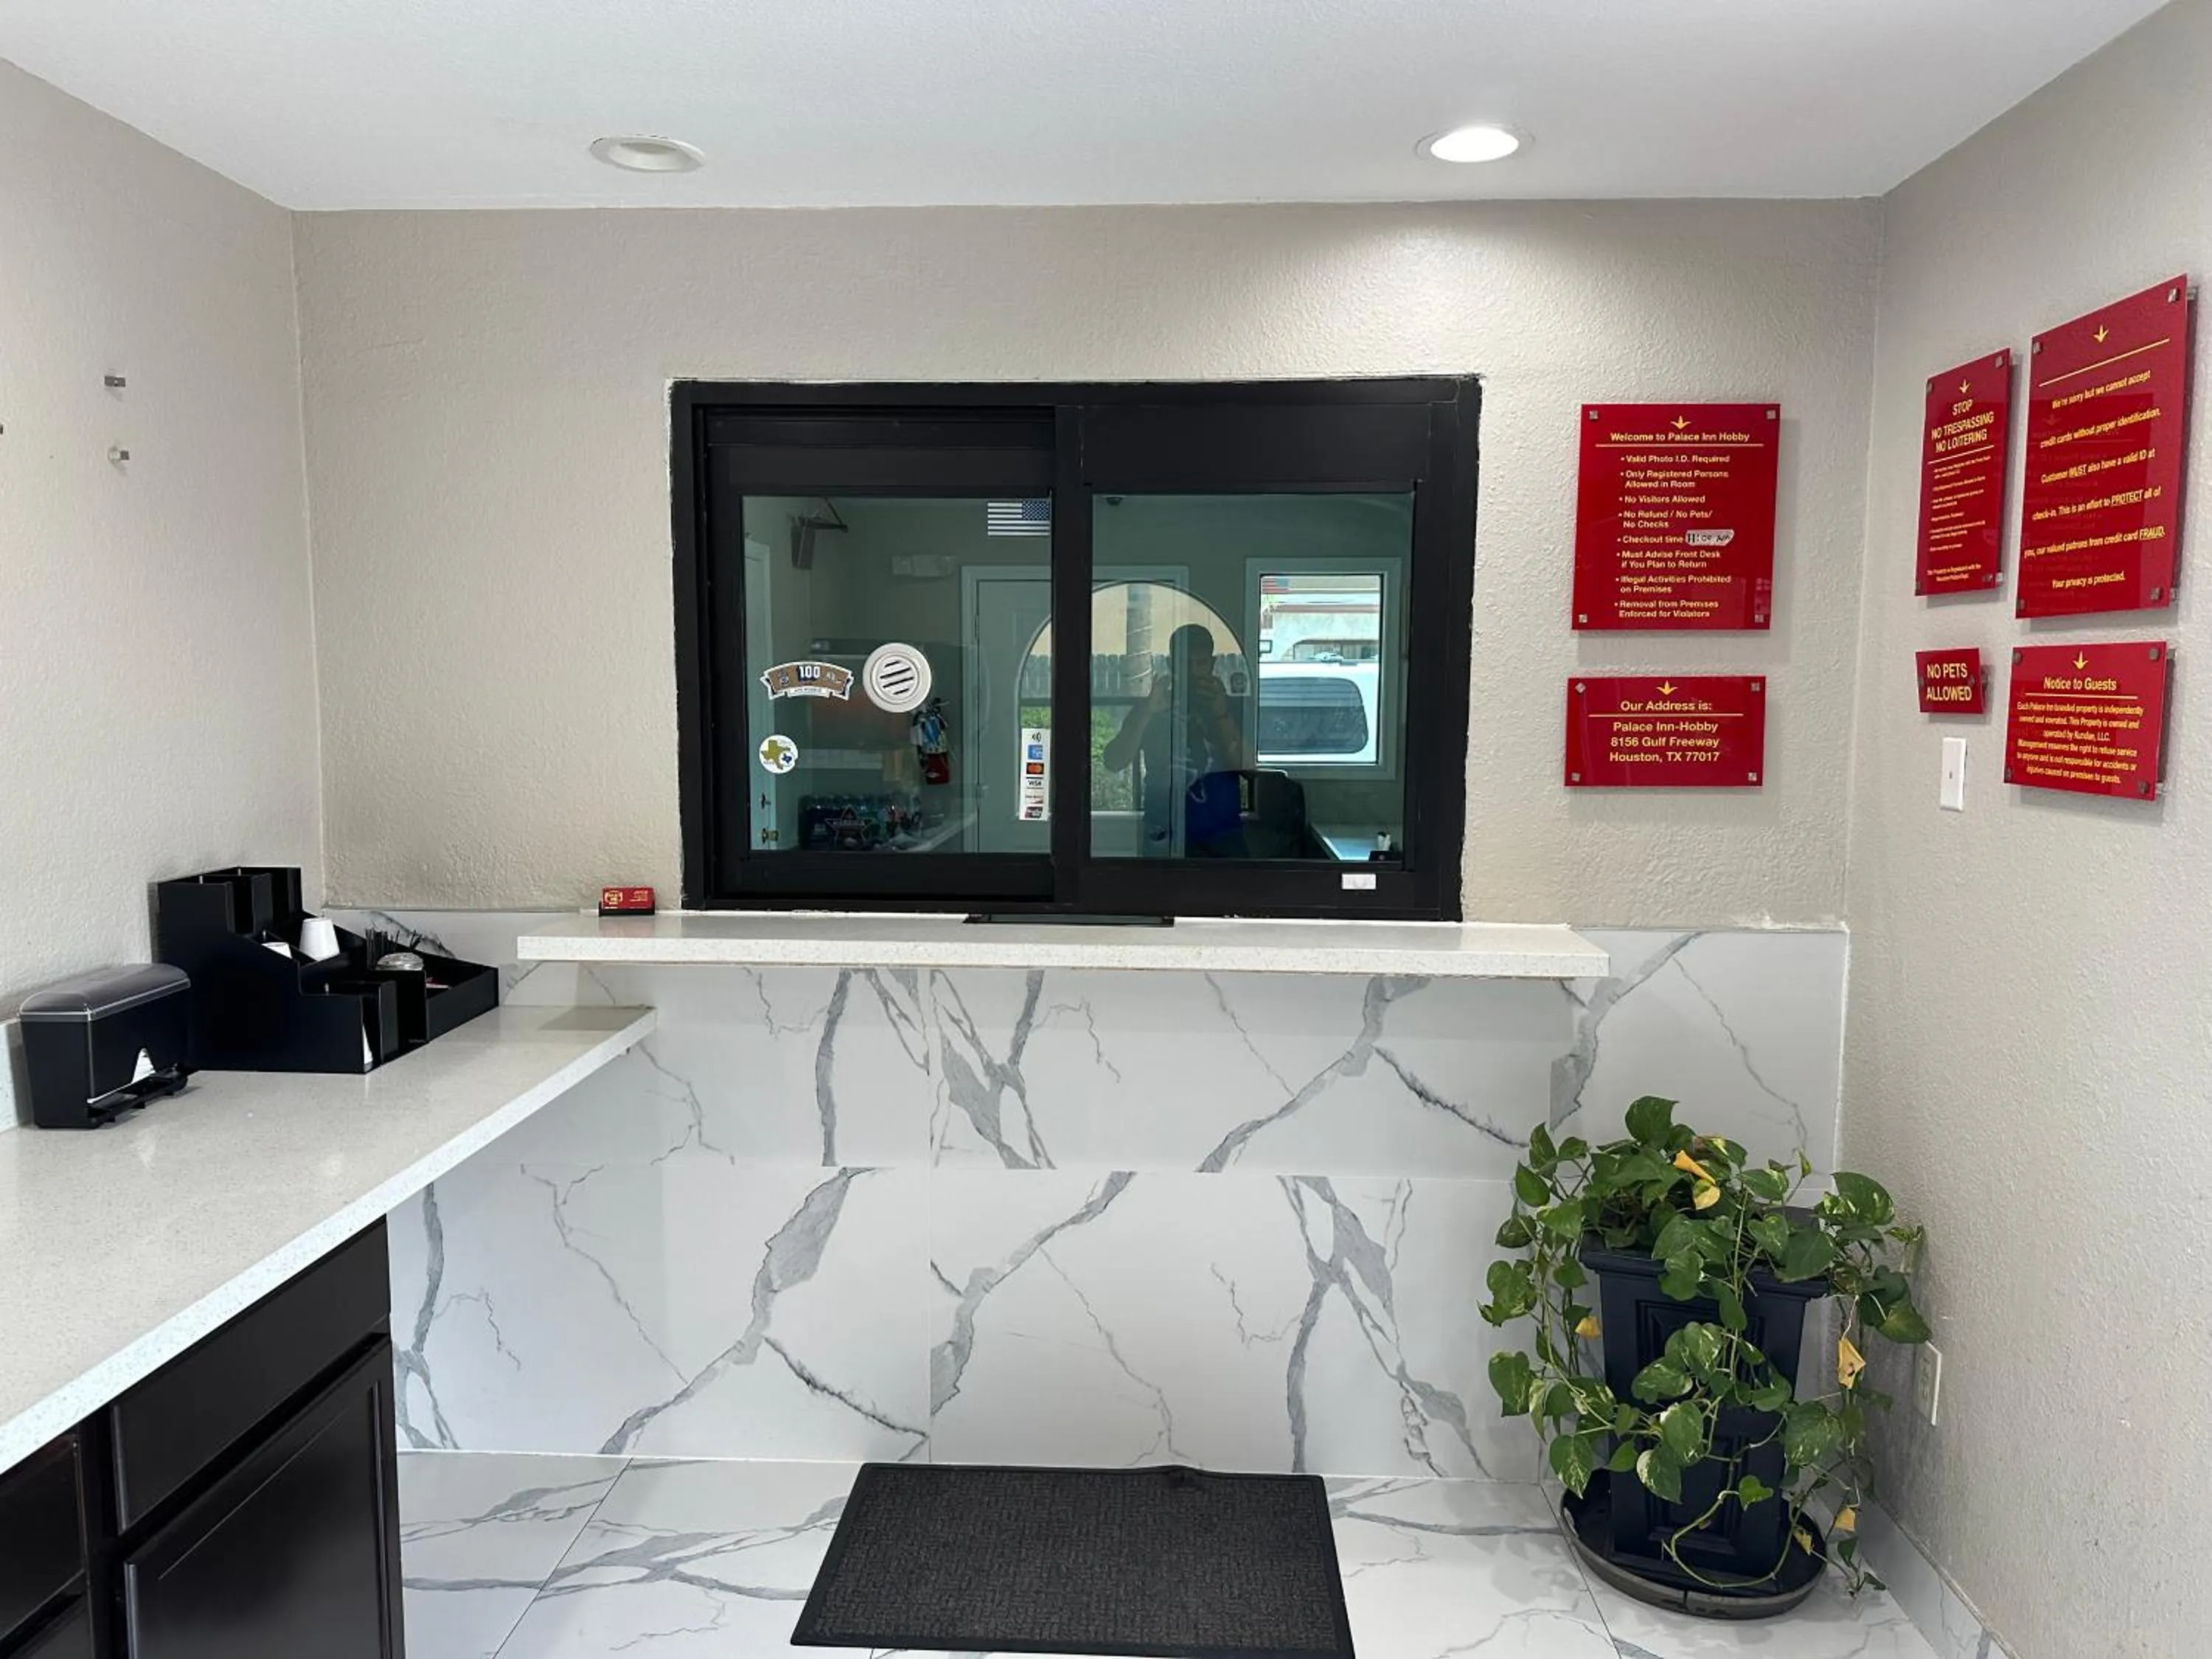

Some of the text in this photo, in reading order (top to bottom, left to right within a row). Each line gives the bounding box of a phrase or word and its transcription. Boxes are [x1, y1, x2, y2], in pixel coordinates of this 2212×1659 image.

[2053, 370, 2150, 409] We're sorry but we cannot accept
[1952, 399, 1972, 416] STOP
[1932, 411, 1994, 440] NO TRESPASSING
[2040, 408, 2160, 448] credit cards without proper identification.
[1610, 433, 1653, 441] Welcome
[1668, 433, 1700, 441] Palace
[1703, 433, 1717, 441] Inn
[1719, 433, 1750, 442] Hobby
[1935, 429, 1987, 453] NO LOITERING
[1692, 455, 1730, 463] Required
[2041, 470, 2067, 484] Customer
[2069, 465, 2087, 478] MUST
[2088, 462, 2100, 473] also
[2101, 459, 2116, 469] have
[2124, 452, 2138, 464] valid
[2140, 450, 2146, 460] ID
[2149, 448, 2155, 459] at
[1626, 470, 1644, 479] Only
[1647, 470, 1691, 479] Registered
[2059, 507, 2070, 515] This
[2072, 505, 2076, 513] is
[2078, 504, 2086, 512] an
[2087, 499, 2102, 510] effort
[2104, 498, 2110, 507] to
[2111, 490, 2143, 507] PROTECT
[2153, 486, 2161, 495] of
[2037, 547, 2046, 555] our
[2047, 543, 2065, 553] valued
[2066, 539, 2087, 552] patrons
[2089, 538, 2103, 546] from
[2104, 533, 2122, 543] credit
[2124, 530, 2138, 540] card
[2139, 526, 2165, 540] FRAUD.
[1621, 576, 1646, 584] Illegal
[2053, 571, 2125, 588] Your privacy is protected.
[799, 666, 821, 678] 100
[1927, 664, 1967, 679] NO PETS
[2044, 677, 2116, 691] Notice to Guests
[1926, 686, 1972, 700] ALLOWED
[1621, 700, 1712, 711] Our Address is:
[1613, 722, 1718, 733] Palace Inn-Hobby
[1610, 737, 1719, 749] 8156 Gulf Freeway
[2097, 732, 2110, 741] LLC.
[1610, 752, 1719, 762] Houston, TX 77017
